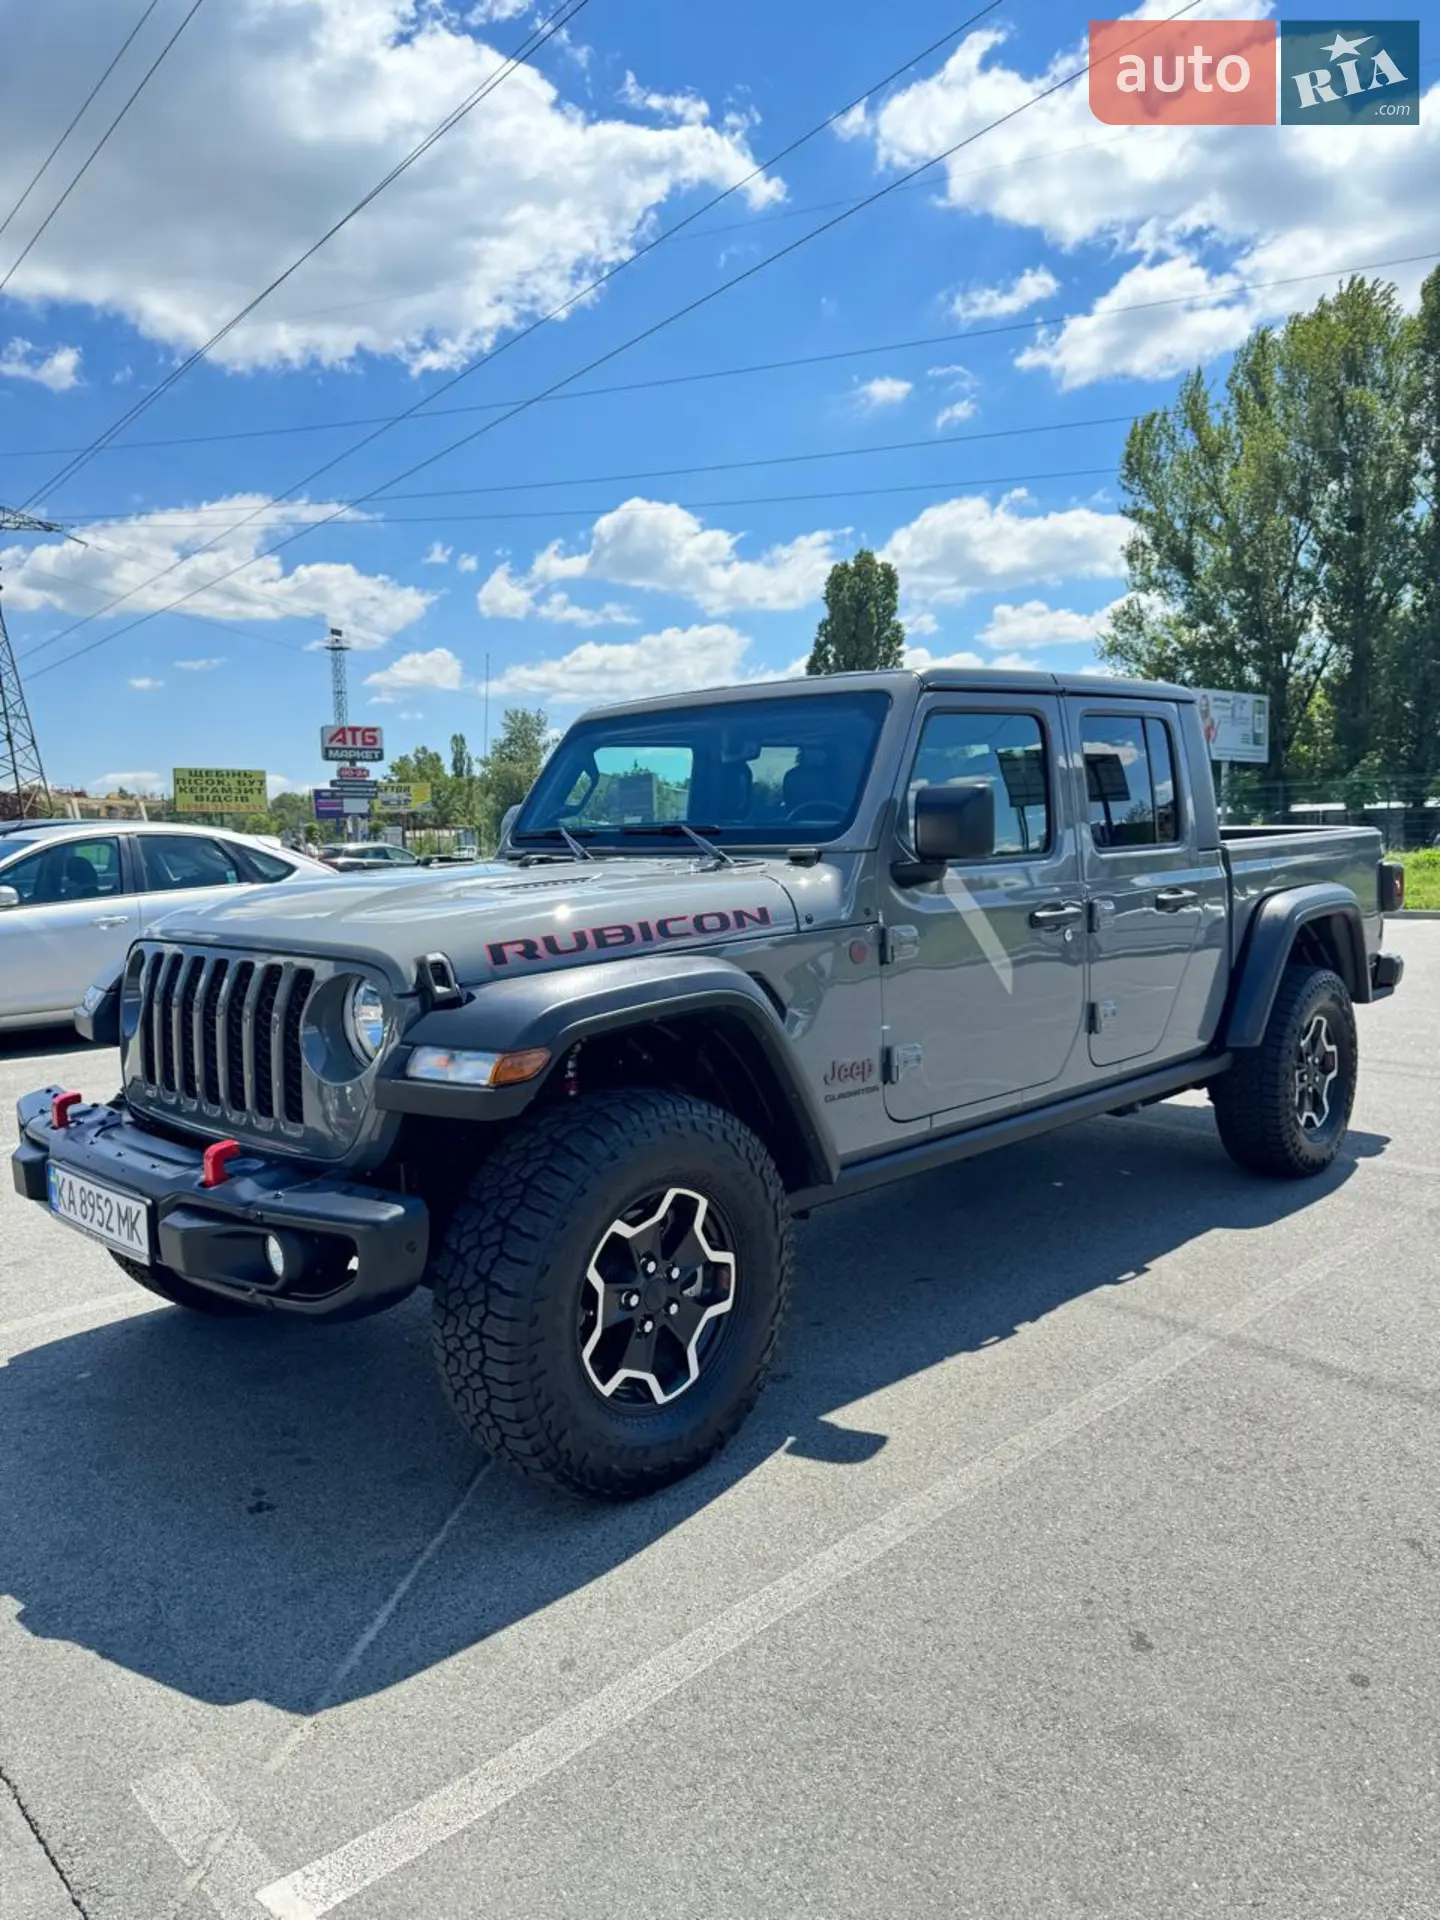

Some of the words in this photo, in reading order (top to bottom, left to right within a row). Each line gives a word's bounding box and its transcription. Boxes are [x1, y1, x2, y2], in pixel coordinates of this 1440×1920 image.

[328, 749, 381, 759] МАРКЕТ
[179, 786, 263, 795] КЕРАМЗИТ
[485, 905, 772, 967] RUBICON
[823, 1057, 875, 1086] Jeep
[58, 1177, 77, 1216] KA
[79, 1186, 115, 1234] 8952
[116, 1201, 143, 1247] MK
